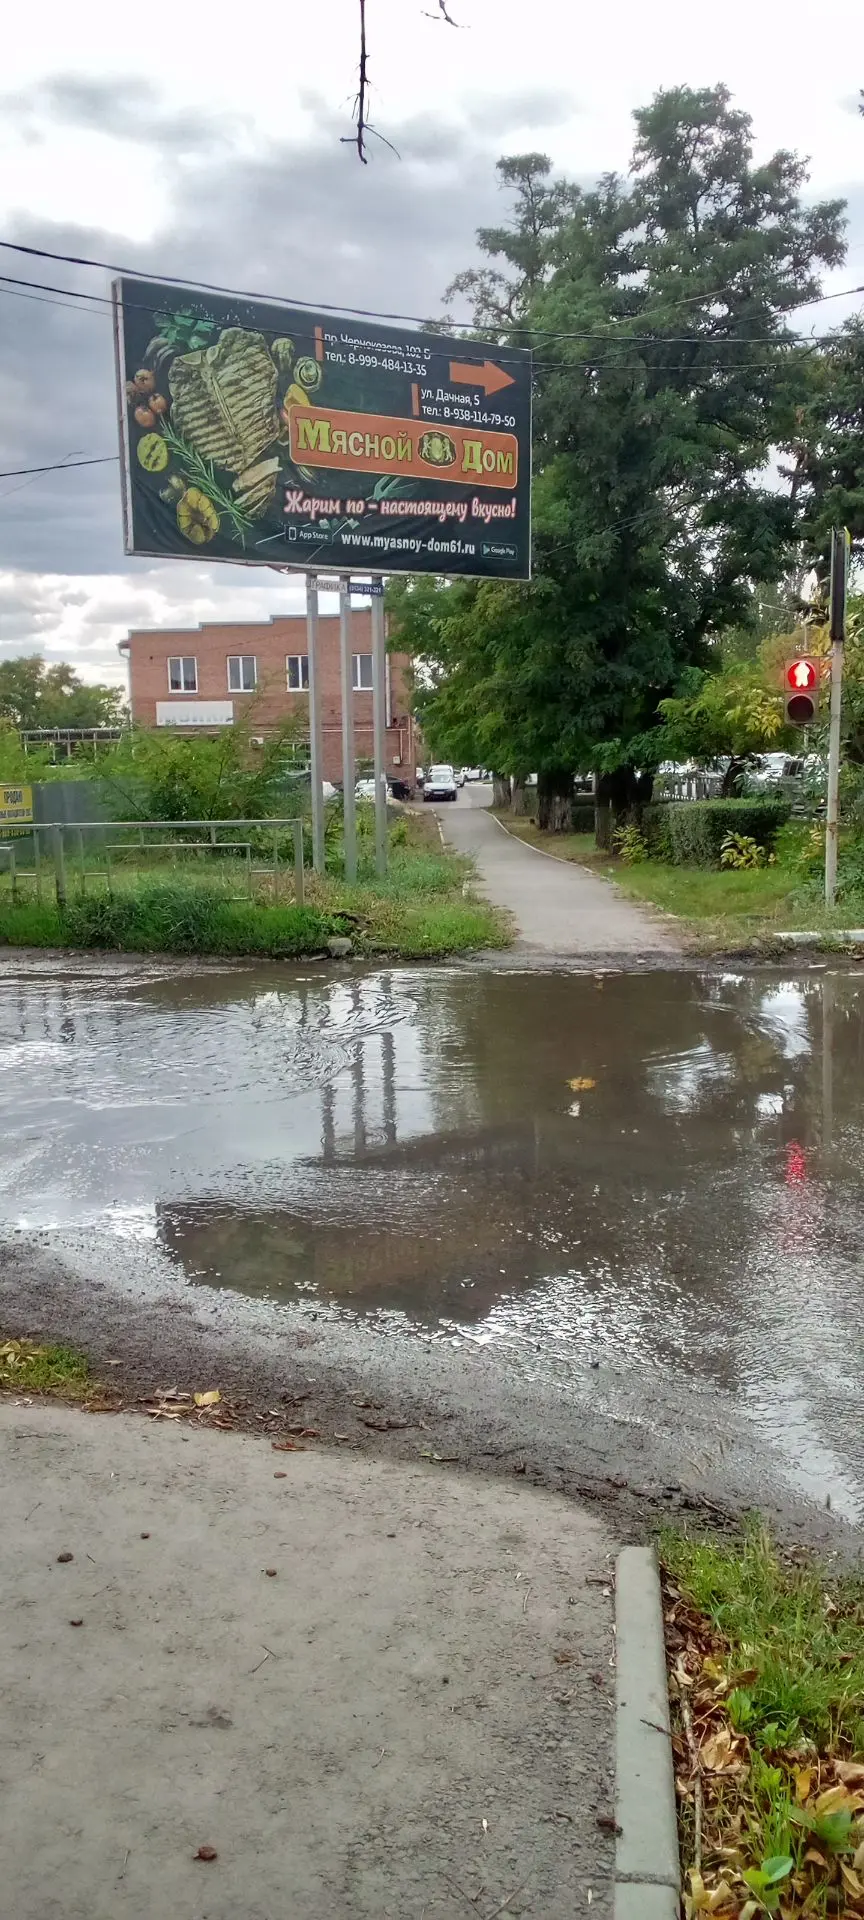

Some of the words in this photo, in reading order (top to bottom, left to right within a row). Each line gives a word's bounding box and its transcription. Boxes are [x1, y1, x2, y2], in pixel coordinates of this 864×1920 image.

[405, 345, 421, 359] 102
[348, 352, 427, 376] 8-999-484-13-35
[420, 388, 434, 400] ул.
[435, 388, 473, 407] Дачная,
[473, 394, 480, 406] 5
[421, 405, 442, 417] тел.:
[443, 406, 516, 427] 8-938-114-79-50
[295, 417, 412, 462] Мясной
[461, 439, 514, 475] Дом
[283, 490, 340, 520] Жарим
[346, 499, 364, 514] по
[380, 502, 468, 522] настоящему
[471, 497, 517, 524] вкусно!
[299, 530, 313, 540] App
[312, 531, 329, 540] Store
[341, 533, 476, 555] www.myasnoy-dom61.ru
